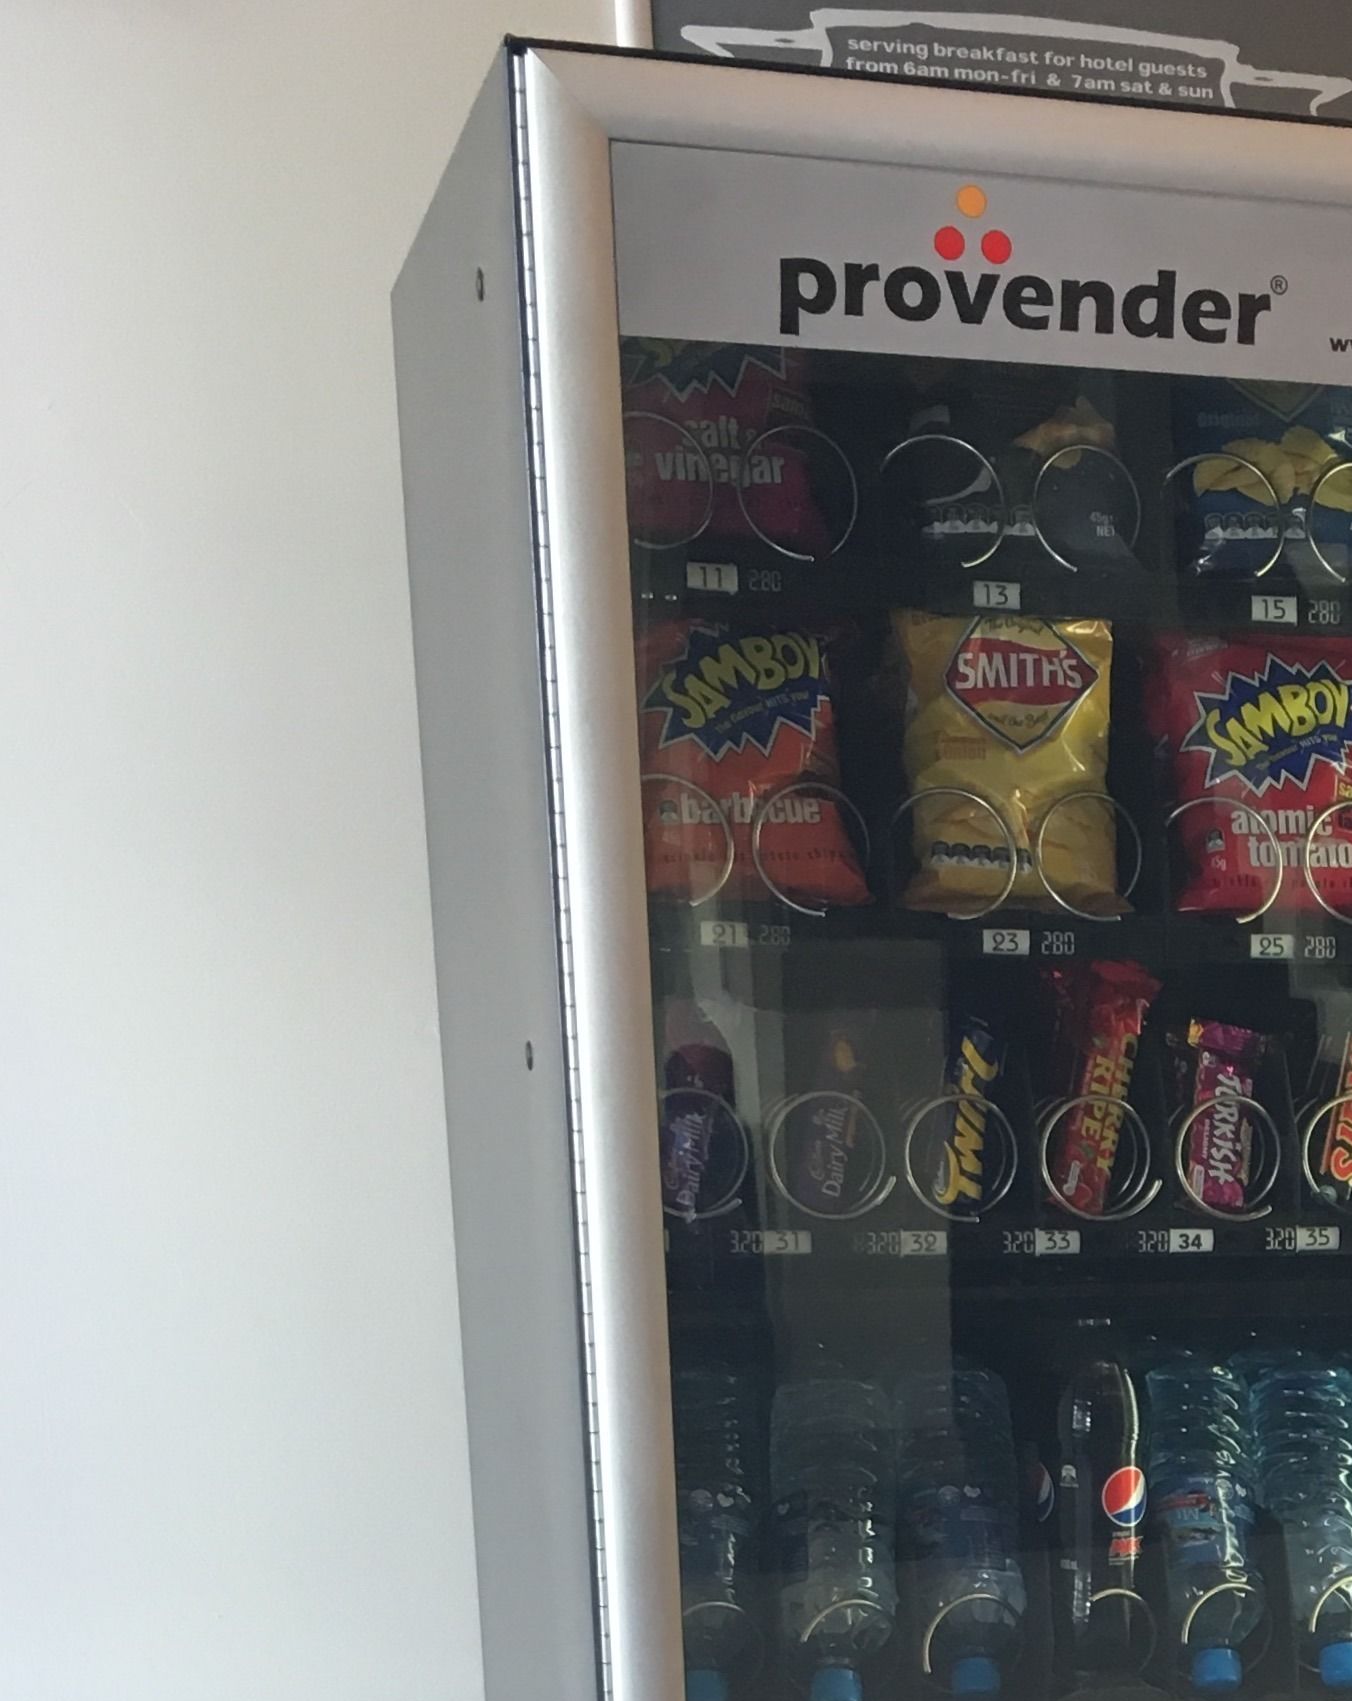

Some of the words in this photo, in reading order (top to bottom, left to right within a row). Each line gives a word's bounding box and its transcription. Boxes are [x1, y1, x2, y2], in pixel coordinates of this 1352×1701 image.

[847, 38, 929, 59] serving
[933, 42, 1040, 66] breakfast
[1044, 50, 1076, 69] for
[1080, 53, 1134, 73] hotel
[1138, 60, 1208, 80] guests
[845, 56, 899, 75] from
[903, 61, 950, 79] 6am
[953, 67, 1037, 86] mon-fri
[1046, 73, 1062, 87] &
[1071, 75, 1116, 92] 7am
[1120, 78, 1154, 95] sat
[1158, 82, 1173, 97] &
[1178, 84, 1214, 100] sun
[699, 567, 724, 589] 11
[983, 587, 1010, 606] 13
[1260, 601, 1286, 619] 15
[661, 632, 826, 730] SAMBOY
[1205, 679, 1350, 767] SAMBOY
[680, 792, 822, 825] barbcue
[1231, 806, 1333, 836] atomic
[712, 923, 738, 946] 21
[993, 932, 1020, 953] 23
[1259, 937, 1285, 957] 25
[1081, 1055, 1111, 1138] RIPE
[1099, 1033, 1138, 1170] CHERRY
[824, 1102, 849, 1146] Milk
[821, 1144, 849, 1198] Dairy
[776, 1232, 800, 1251] 31
[911, 1233, 938, 1252] 32
[1044, 1232, 1071, 1250] 33
[1178, 1232, 1203, 1250] 34
[1305, 1227, 1330, 1246] 35
